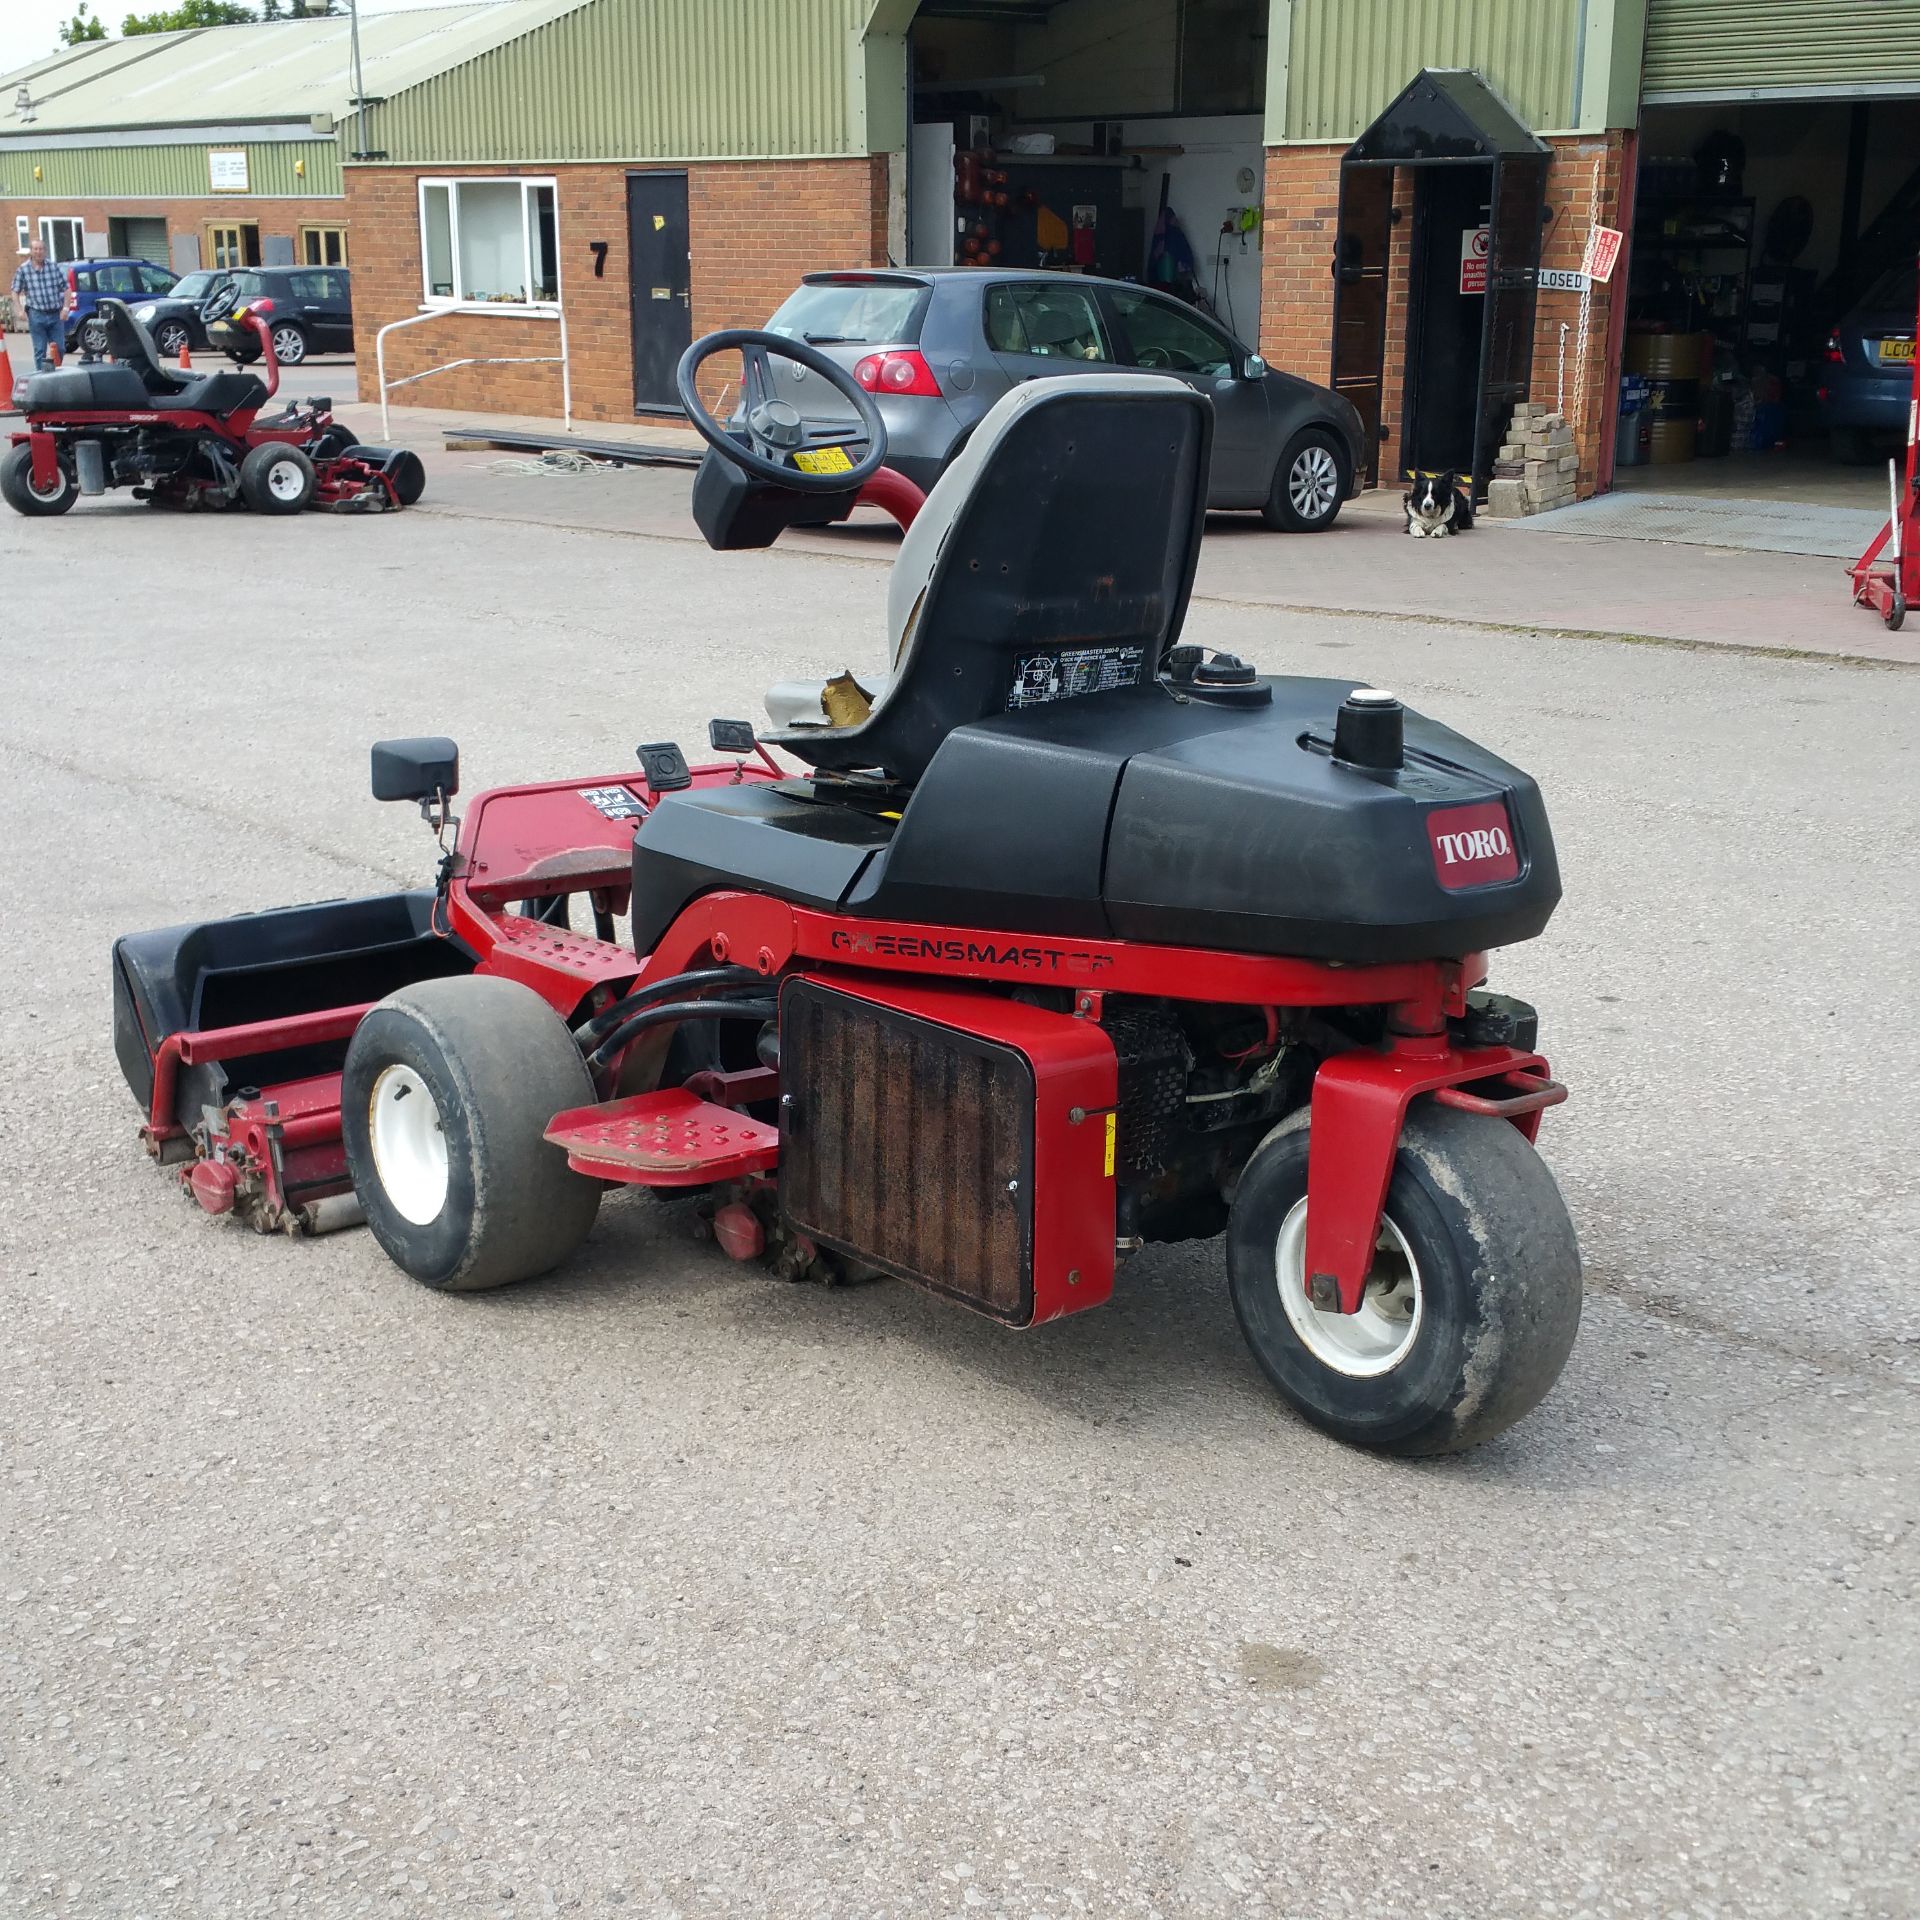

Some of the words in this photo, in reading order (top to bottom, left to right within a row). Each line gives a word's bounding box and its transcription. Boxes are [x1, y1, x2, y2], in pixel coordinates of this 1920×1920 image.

[590, 242, 608, 278] 7
[1537, 271, 1583, 288] LOSED
[1436, 826, 1508, 865] TORO
